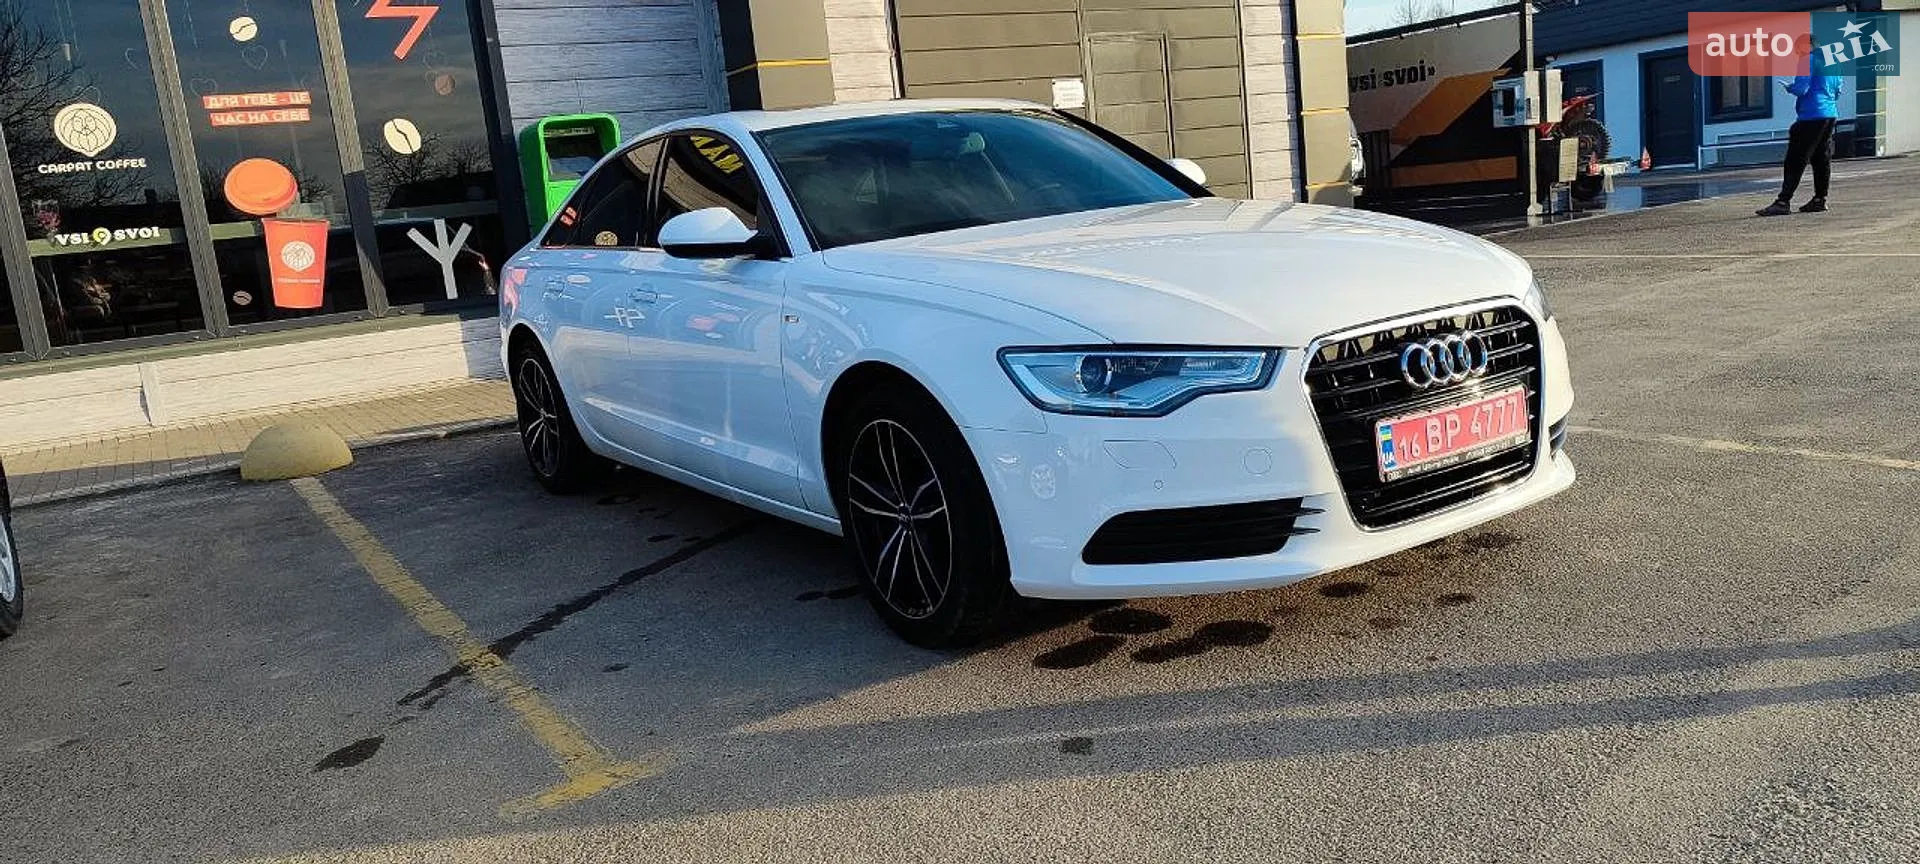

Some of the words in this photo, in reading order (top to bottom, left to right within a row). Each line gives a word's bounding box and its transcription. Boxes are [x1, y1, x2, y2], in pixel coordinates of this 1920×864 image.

[209, 95, 239, 107] ДЛЯ
[243, 93, 277, 106] ТЕБЕ
[289, 92, 310, 104] ЦЕ
[214, 112, 245, 124] ЧАС
[248, 111, 270, 122] НА
[272, 109, 309, 121] СЕБЕ
[38, 161, 93, 174] CARPAT
[96, 158, 147, 170] COFFEE
[55, 232, 90, 246] VSI
[113, 226, 160, 241] SVOI
[1399, 433, 1421, 461] 16
[1471, 396, 1518, 440] 4777
